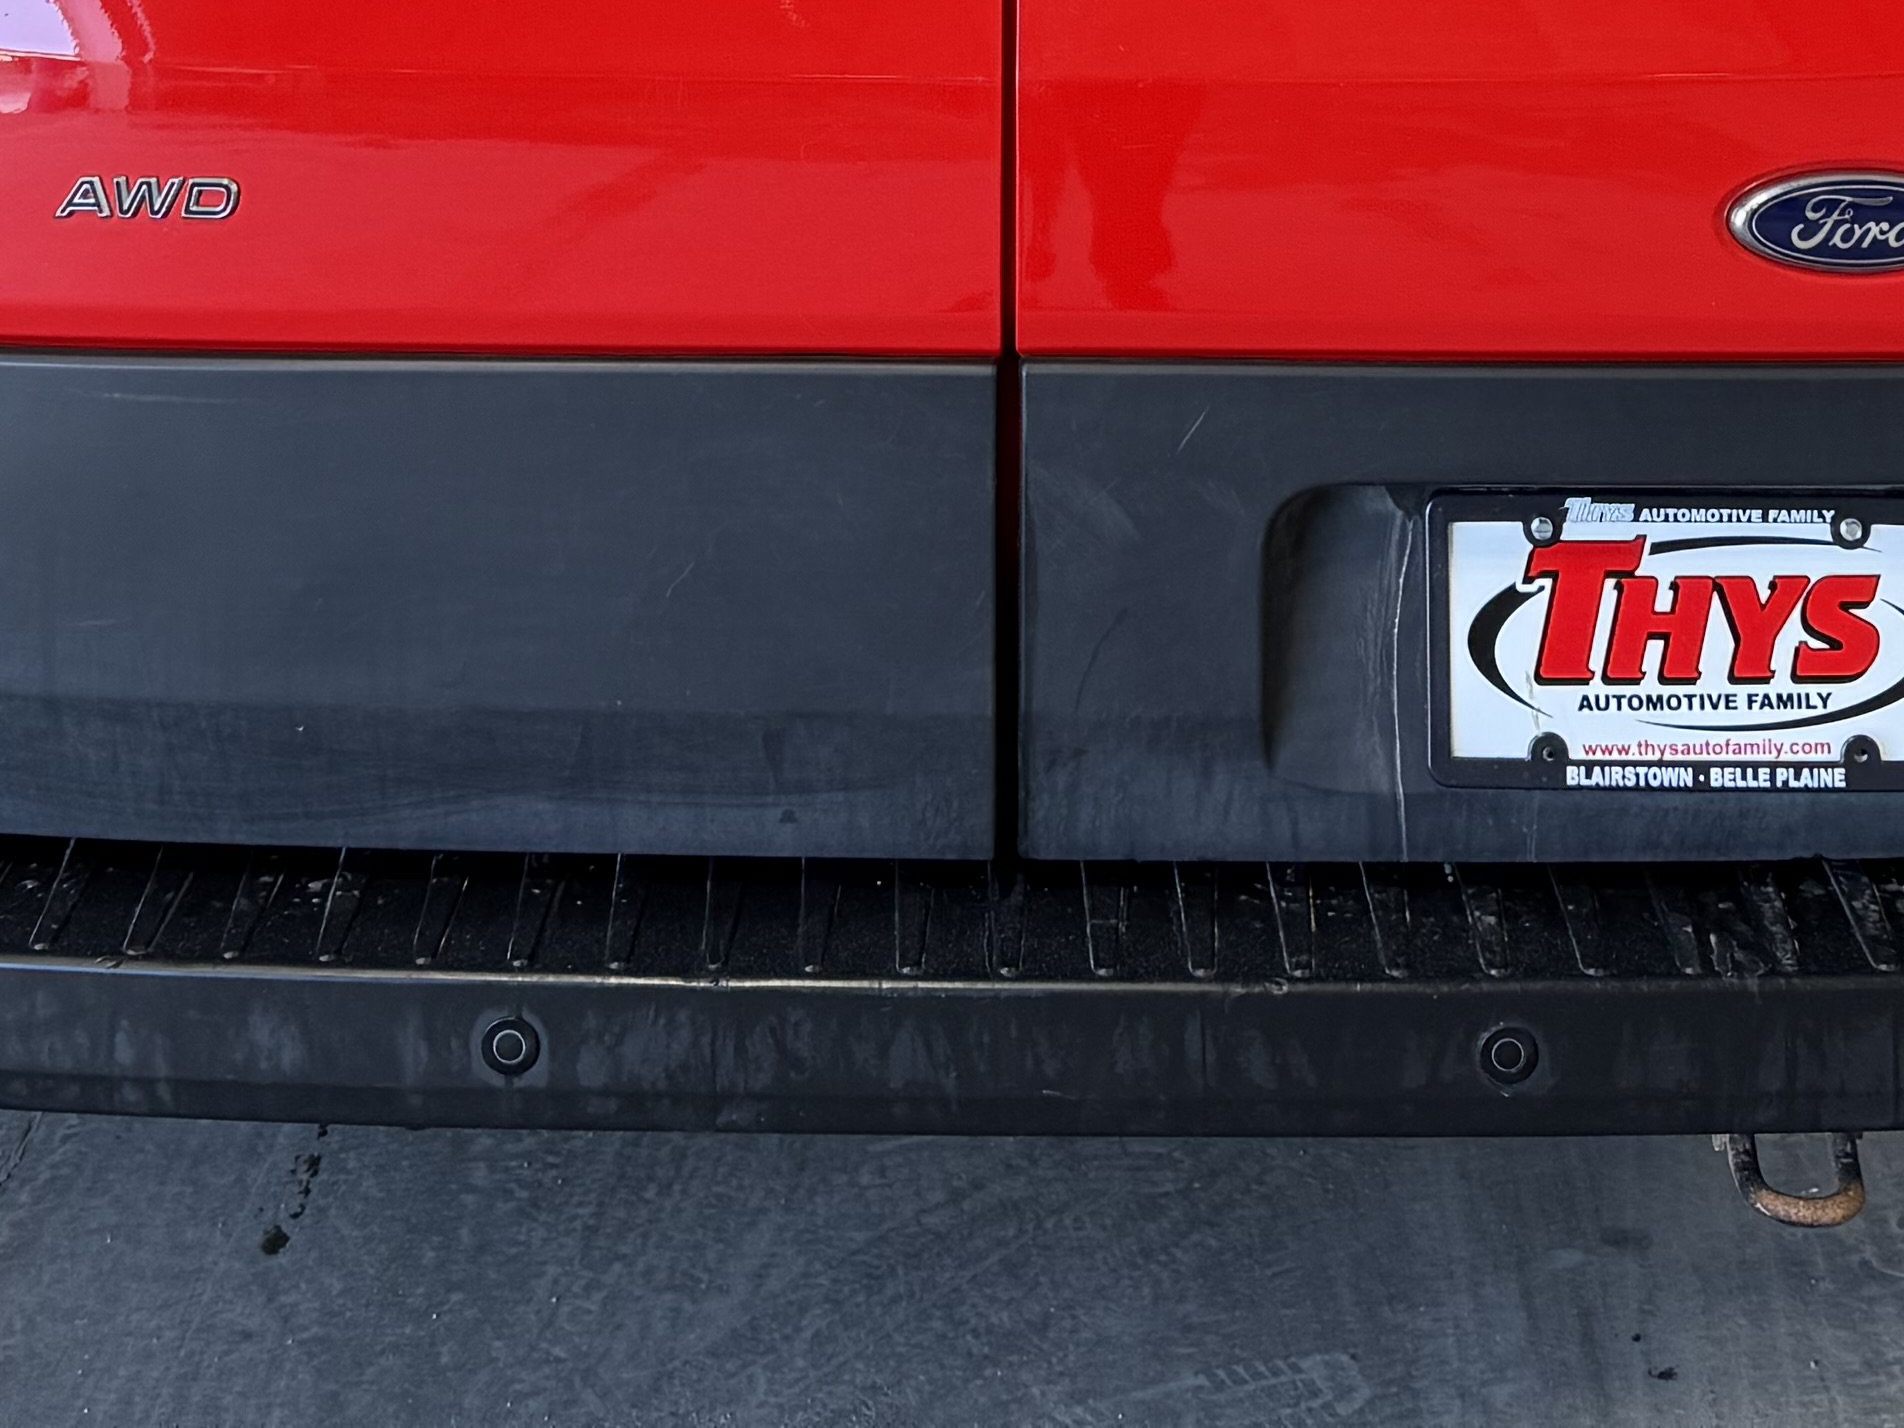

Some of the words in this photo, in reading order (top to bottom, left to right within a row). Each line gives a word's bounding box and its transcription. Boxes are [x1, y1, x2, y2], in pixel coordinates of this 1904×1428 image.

[54, 175, 241, 221] AWD
[1638, 507, 1763, 523] AUTOMOTIVE
[1767, 509, 1836, 523] FAMILY
[1523, 534, 1881, 685] THYS
[1577, 693, 1739, 712] AUTOMOTIVE
[1746, 691, 1834, 711] FAMILY
[1582, 738, 1832, 760] www.thysautofamily.com
[1565, 766, 1694, 789] BLAIRSTOWN
[1709, 766, 1773, 788] BELLE
[1775, 767, 1847, 789] PLAINE
